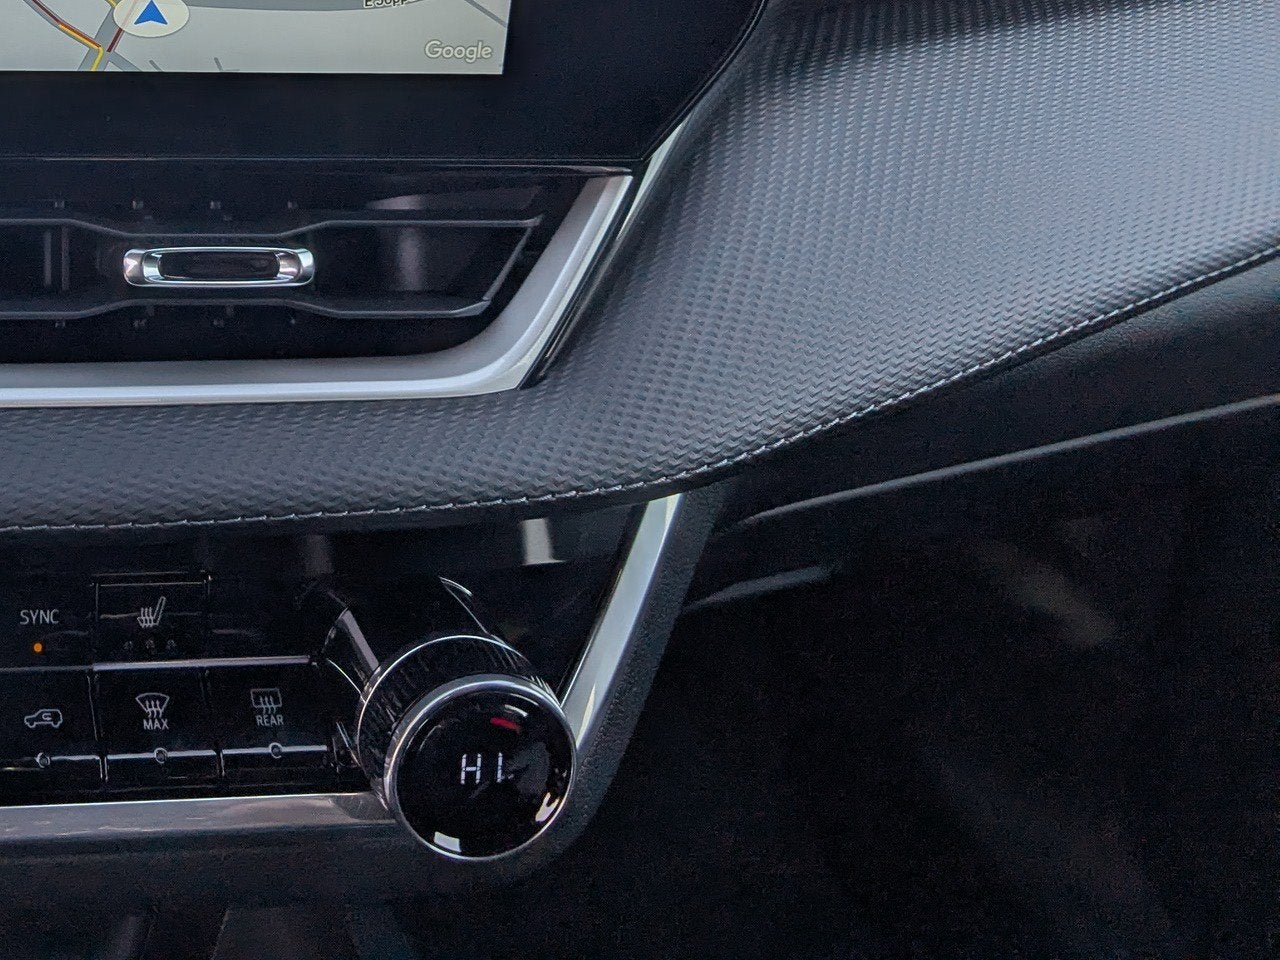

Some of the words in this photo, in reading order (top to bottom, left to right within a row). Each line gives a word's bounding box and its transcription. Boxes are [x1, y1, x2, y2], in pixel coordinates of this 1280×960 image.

[424, 39, 493, 63] Google
[20, 609, 60, 625] SYNC
[143, 718, 169, 730] MAX
[256, 714, 284, 727] REAR
